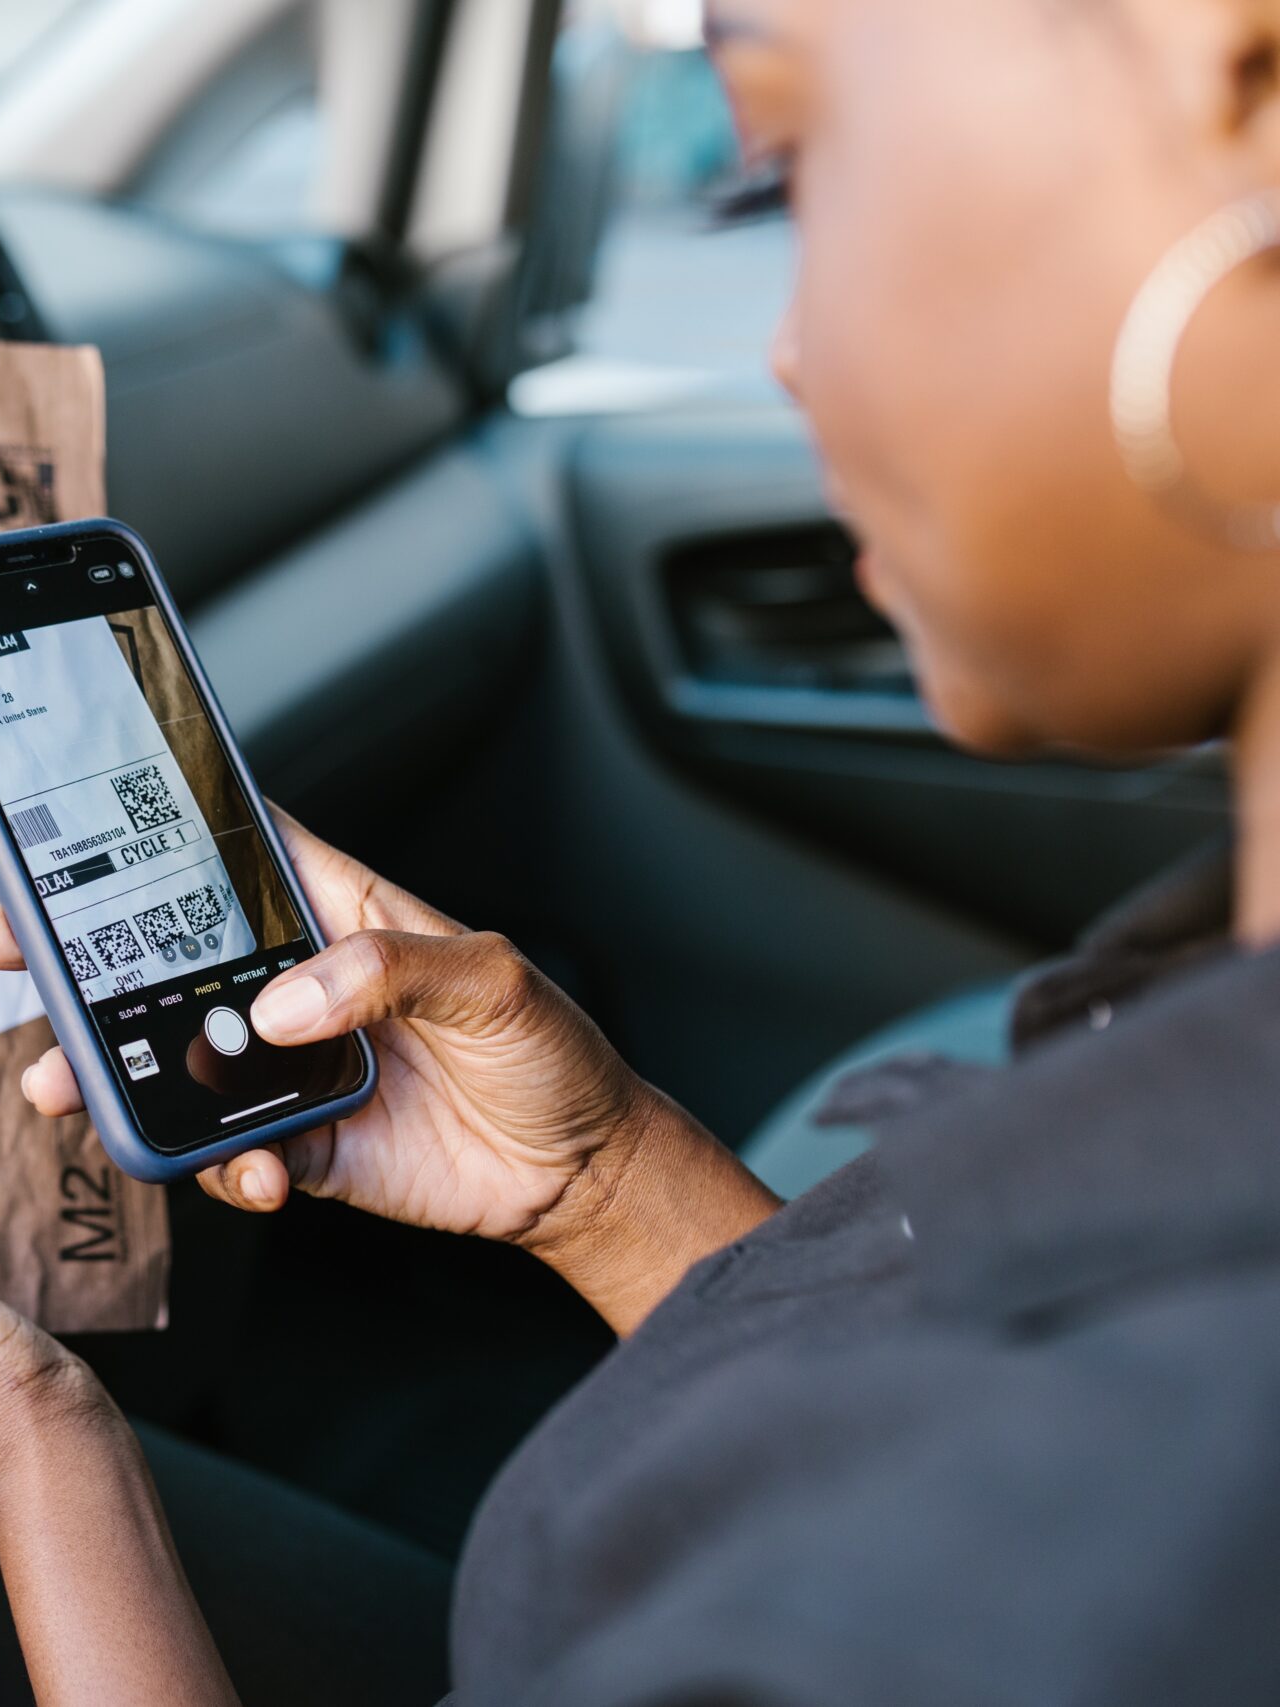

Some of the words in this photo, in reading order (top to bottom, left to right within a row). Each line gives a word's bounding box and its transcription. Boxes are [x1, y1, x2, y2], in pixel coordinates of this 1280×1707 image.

[1, 692, 15, 704] 28
[3, 711, 26, 723] United
[27, 705, 48, 717] States
[35, 870, 74, 896] DLA4
[121, 833, 171, 865] CYCLE
[175, 828, 187, 844] 1
[49, 826, 127, 862] TBA198856383104
[116, 969, 144, 987] ONT1
[118, 1004, 147, 1020] SLO-MO
[158, 993, 183, 1007] VIDEO
[194, 981, 222, 996] PHOTO
[232, 966, 269, 984] PORTRAIT
[60, 1165, 115, 1262] M2
